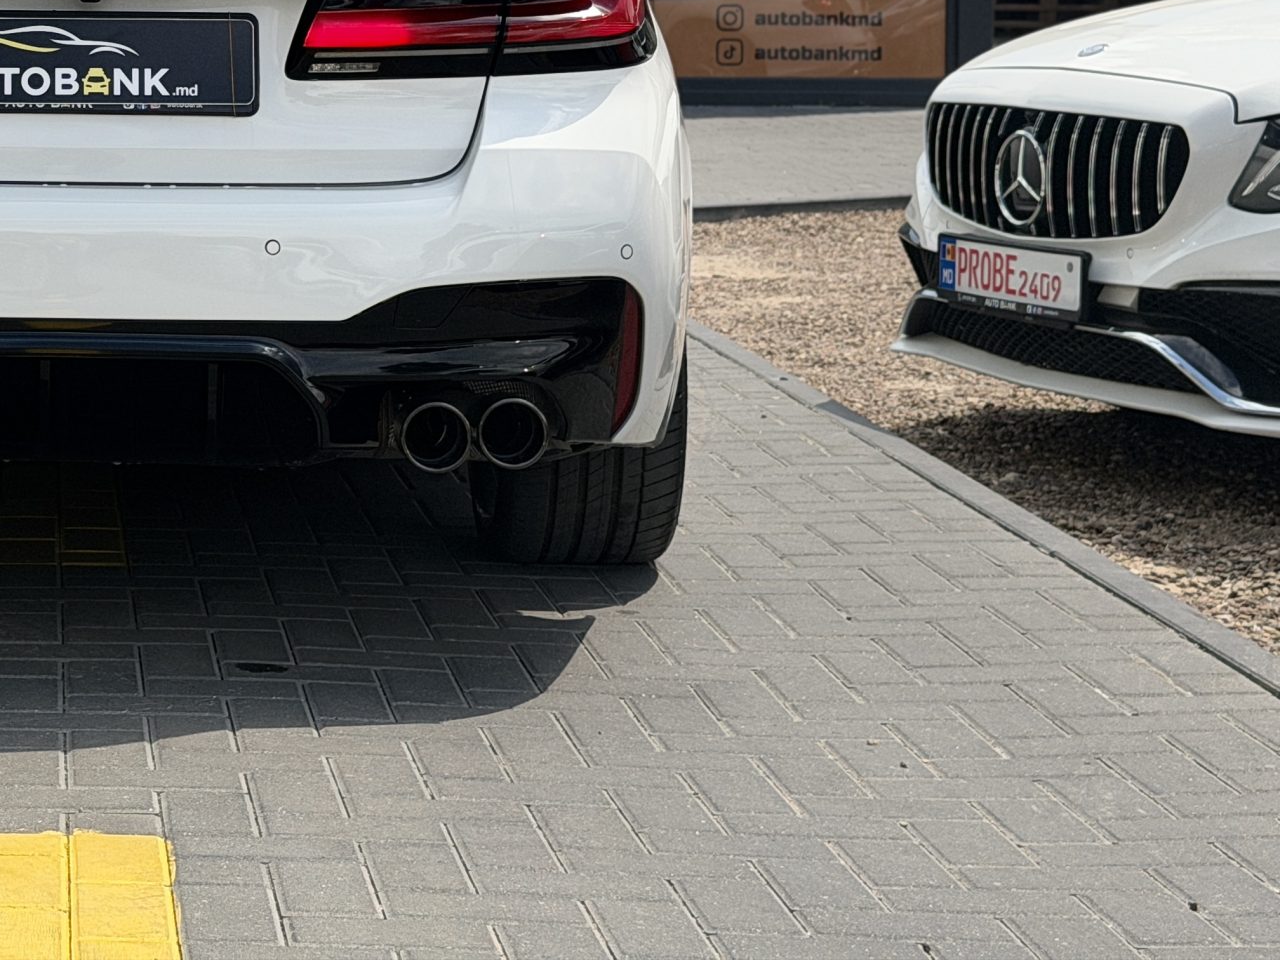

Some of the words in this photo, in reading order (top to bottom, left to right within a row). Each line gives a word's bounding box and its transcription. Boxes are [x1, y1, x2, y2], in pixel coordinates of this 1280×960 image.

[754, 11, 883, 27] autobankmd
[754, 46, 883, 62] autobankmd
[942, 268, 954, 285] MD
